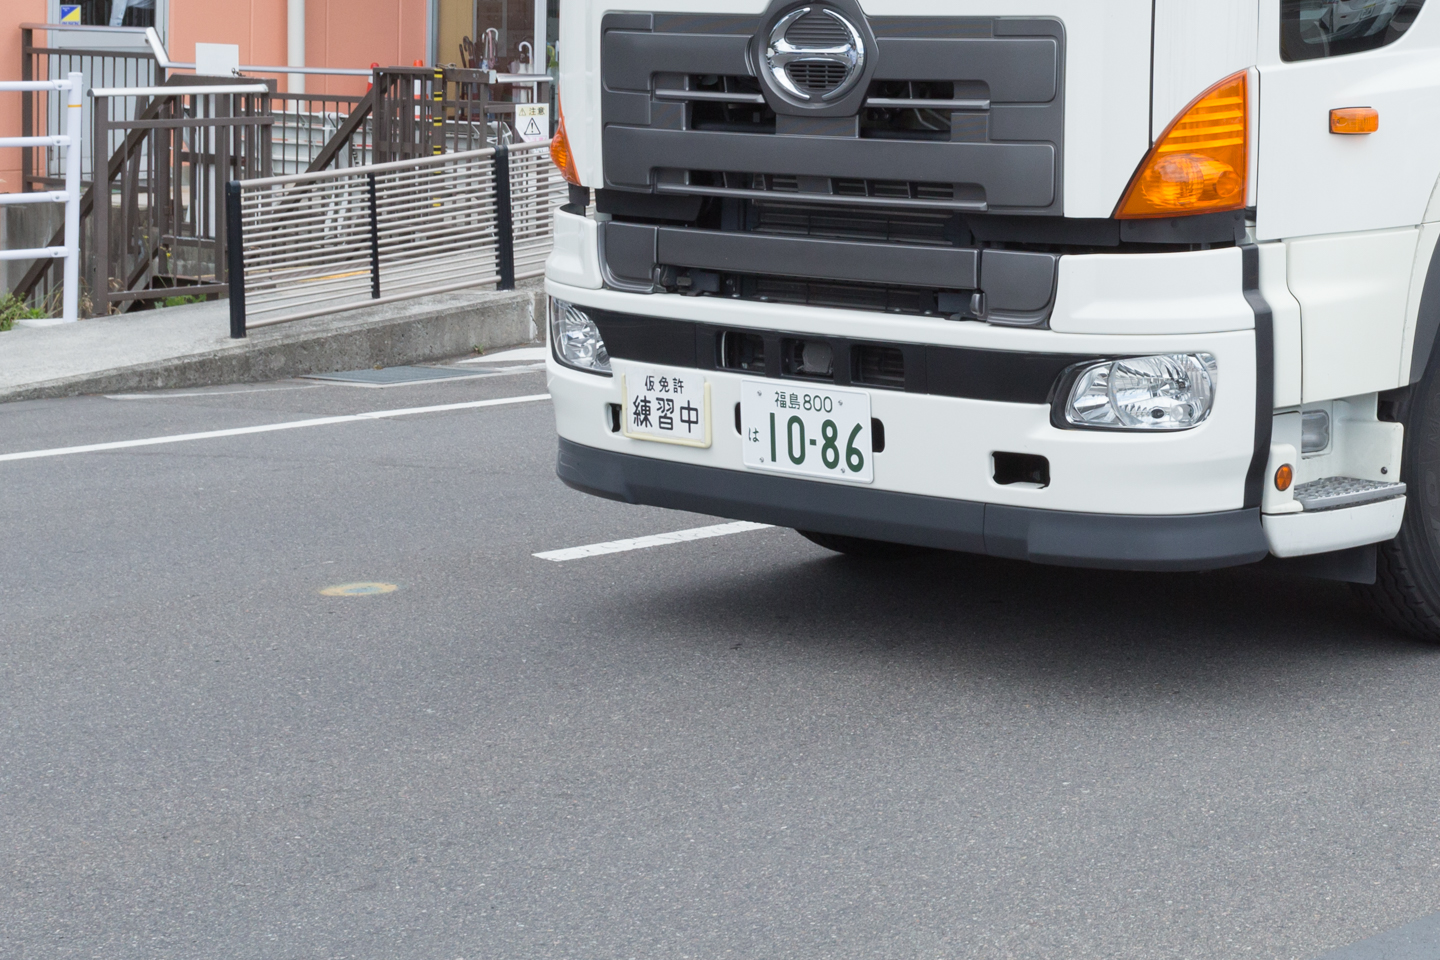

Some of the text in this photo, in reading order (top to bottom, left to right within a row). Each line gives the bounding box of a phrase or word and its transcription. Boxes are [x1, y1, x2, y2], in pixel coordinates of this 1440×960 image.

[529, 106, 545, 116] 注意
[644, 375, 685, 395] 仮免許
[632, 395, 699, 434] 練習中
[748, 411, 865, 473] は 10-86
